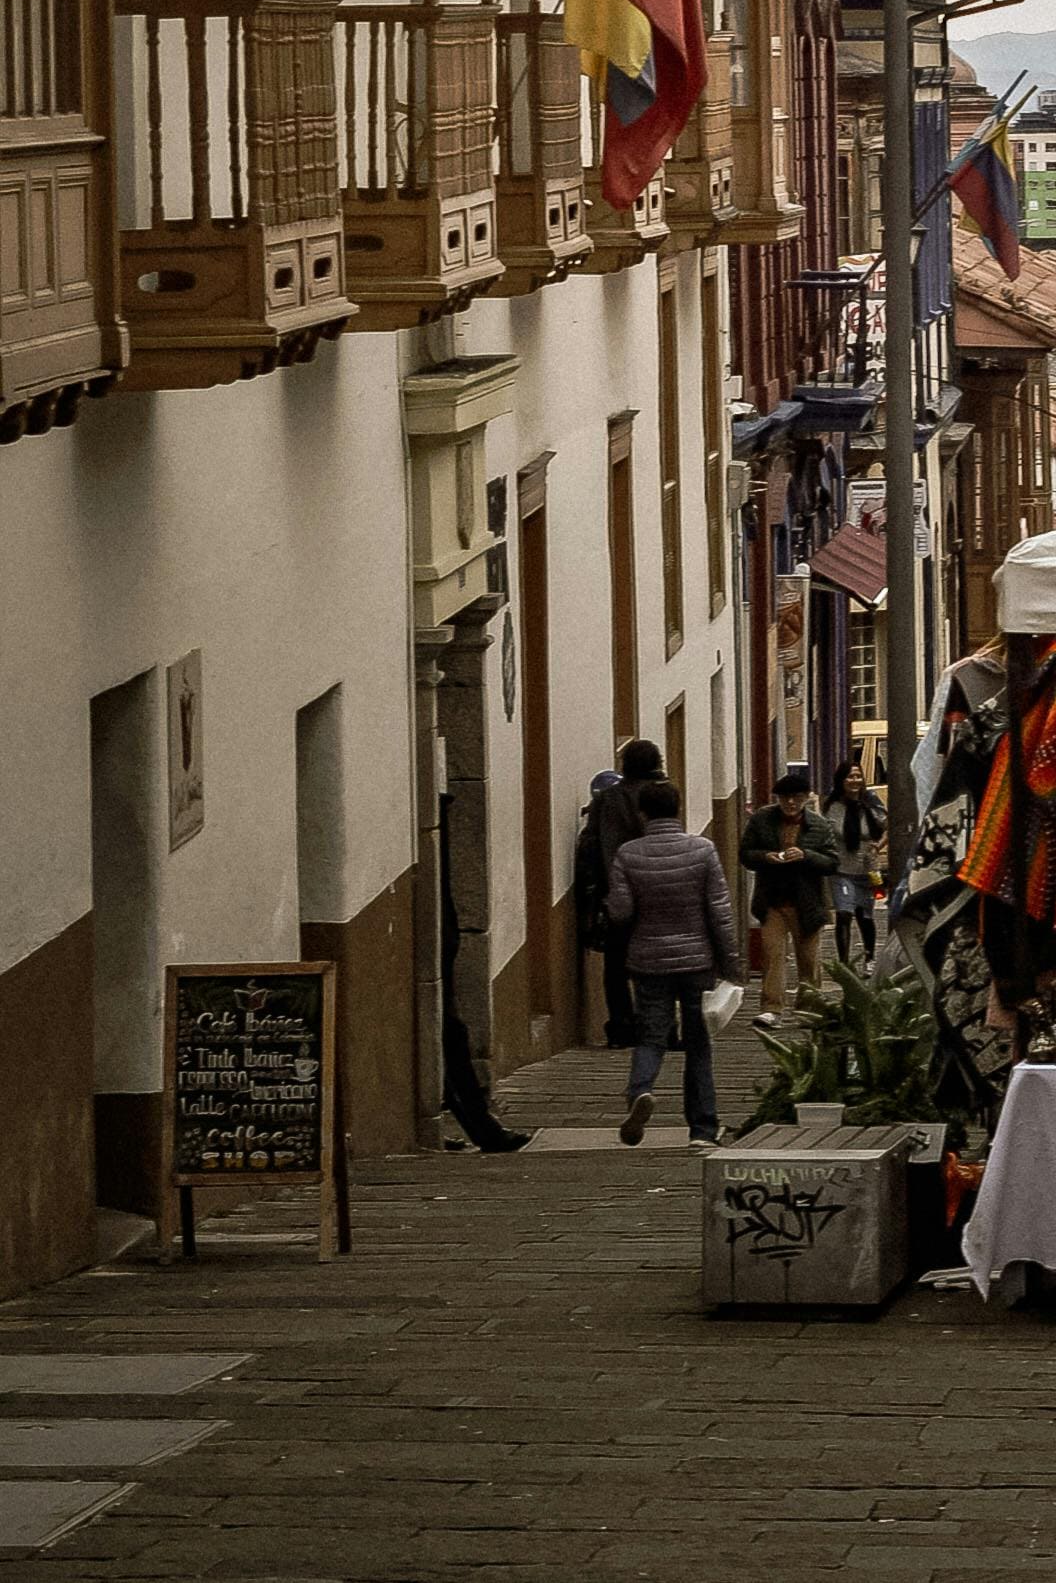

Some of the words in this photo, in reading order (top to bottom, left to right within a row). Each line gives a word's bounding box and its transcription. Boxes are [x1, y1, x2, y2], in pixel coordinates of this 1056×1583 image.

[196, 1011, 237, 1033] Café
[194, 1047, 237, 1069] Tinto
[201, 1150, 296, 1169] SHOP
